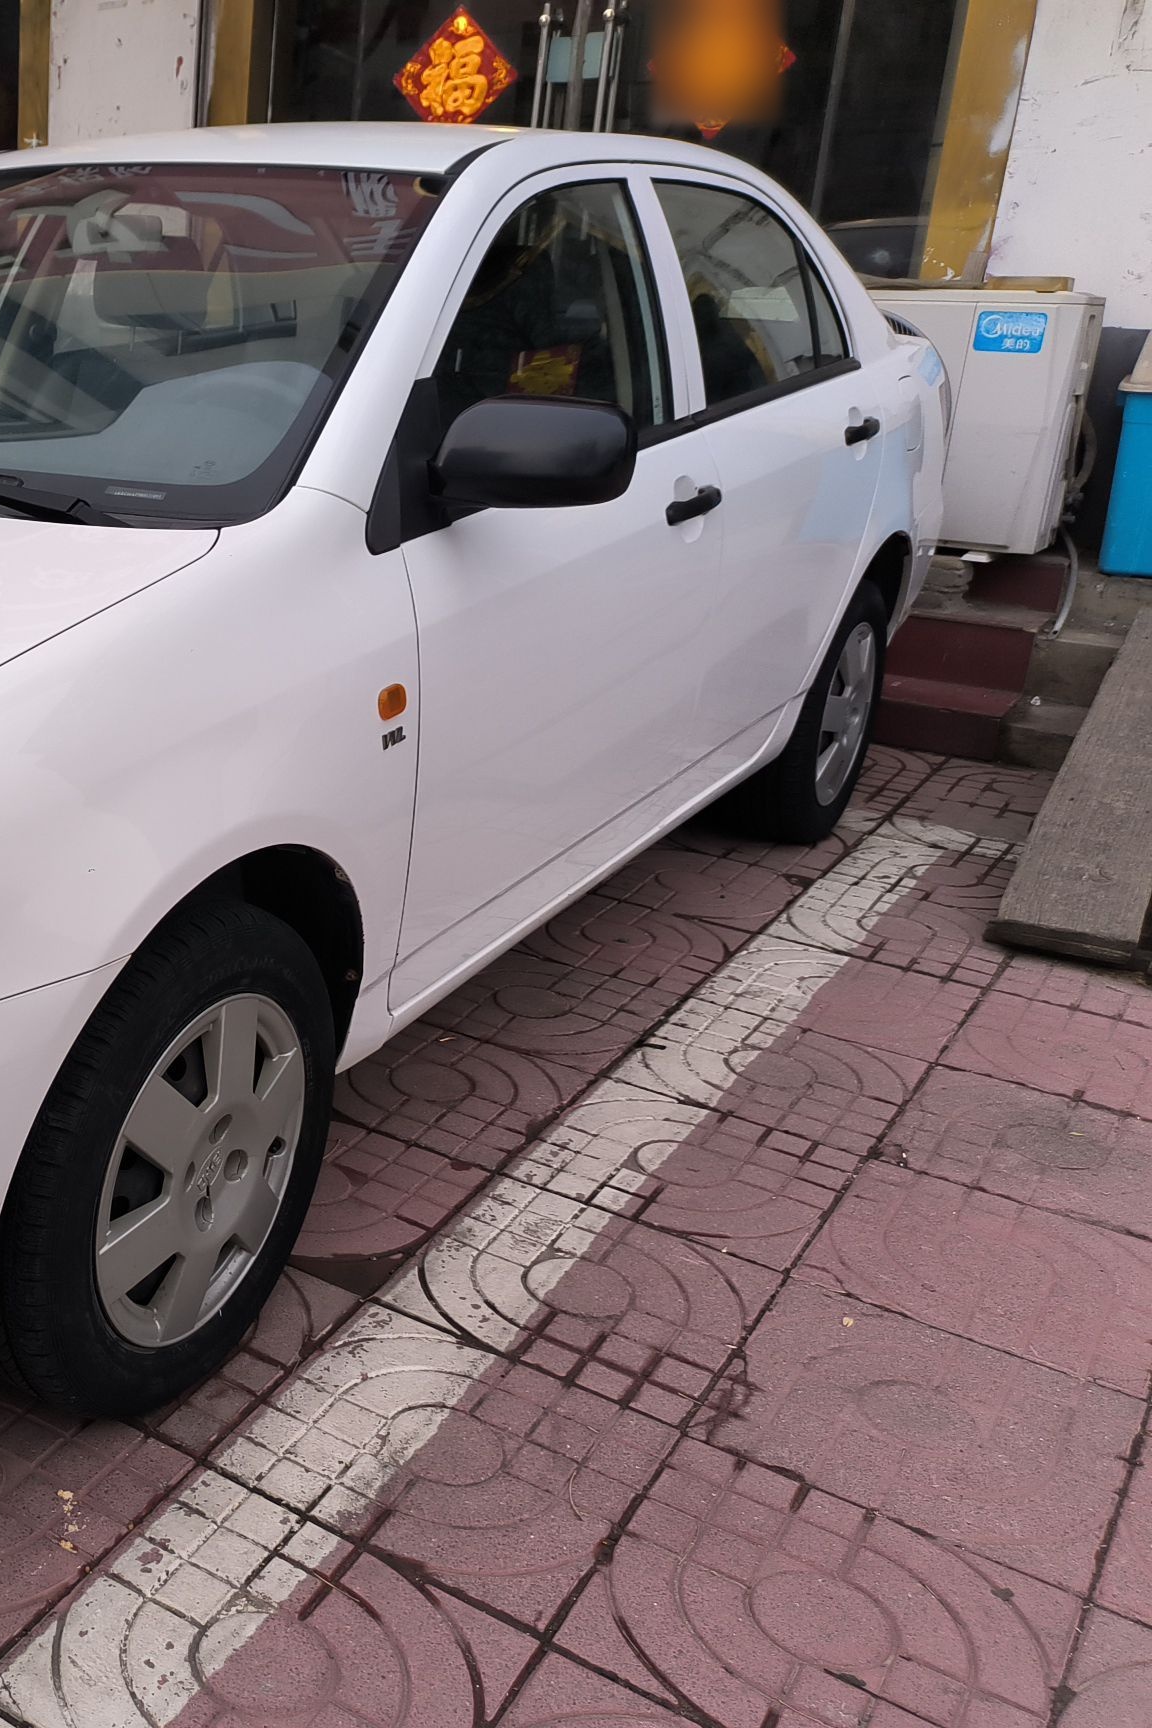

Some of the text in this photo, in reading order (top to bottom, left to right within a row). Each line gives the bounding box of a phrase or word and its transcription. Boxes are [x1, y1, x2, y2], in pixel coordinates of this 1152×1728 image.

[420, 35, 489, 116] 福
[984, 317, 1041, 337] Midea
[1001, 337, 1030, 350] 美的
